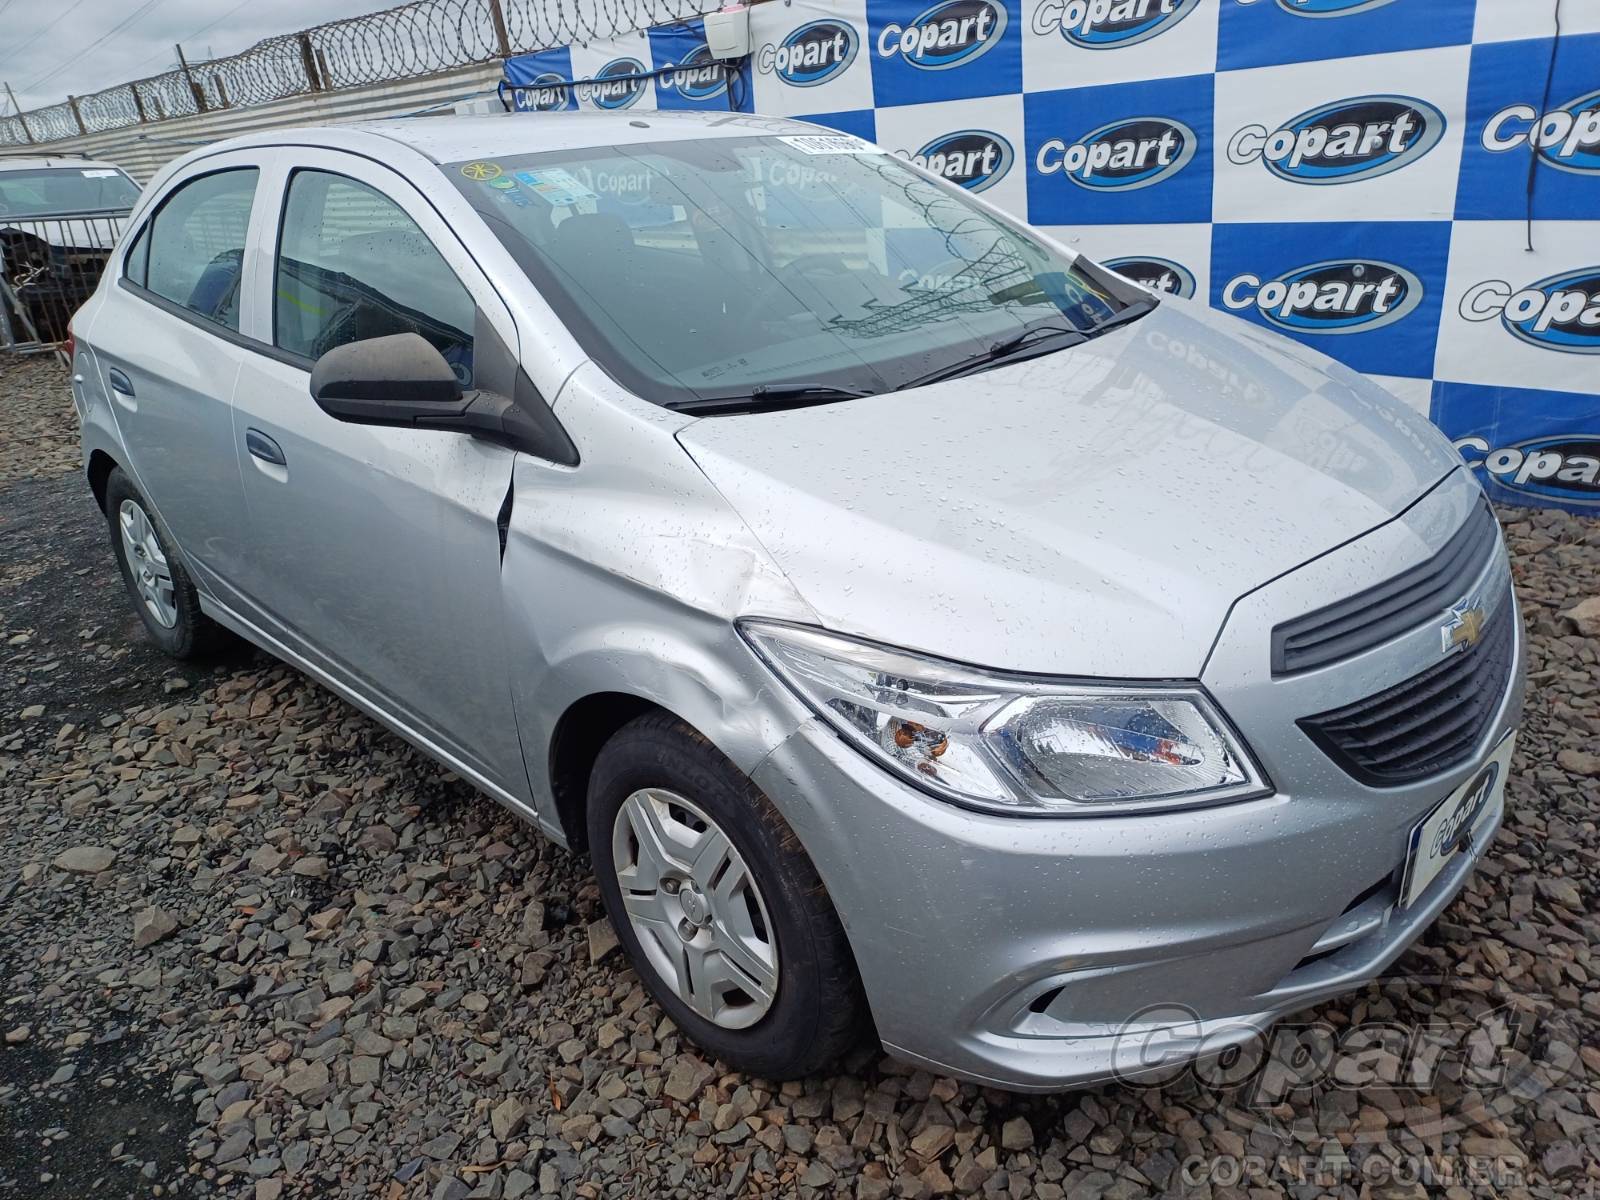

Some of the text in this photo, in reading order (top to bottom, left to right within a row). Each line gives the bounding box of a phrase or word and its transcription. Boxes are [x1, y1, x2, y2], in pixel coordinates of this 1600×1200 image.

[757, 34, 845, 75] Copart
[878, 11, 992, 58] Copart
[515, 86, 564, 110] Copart
[659, 63, 728, 90] Copar
[1035, 130, 1177, 178] Copart
[1227, 108, 1416, 168] Copart
[1222, 272, 1399, 318] Copart
[1430, 773, 1491, 860] Copart
